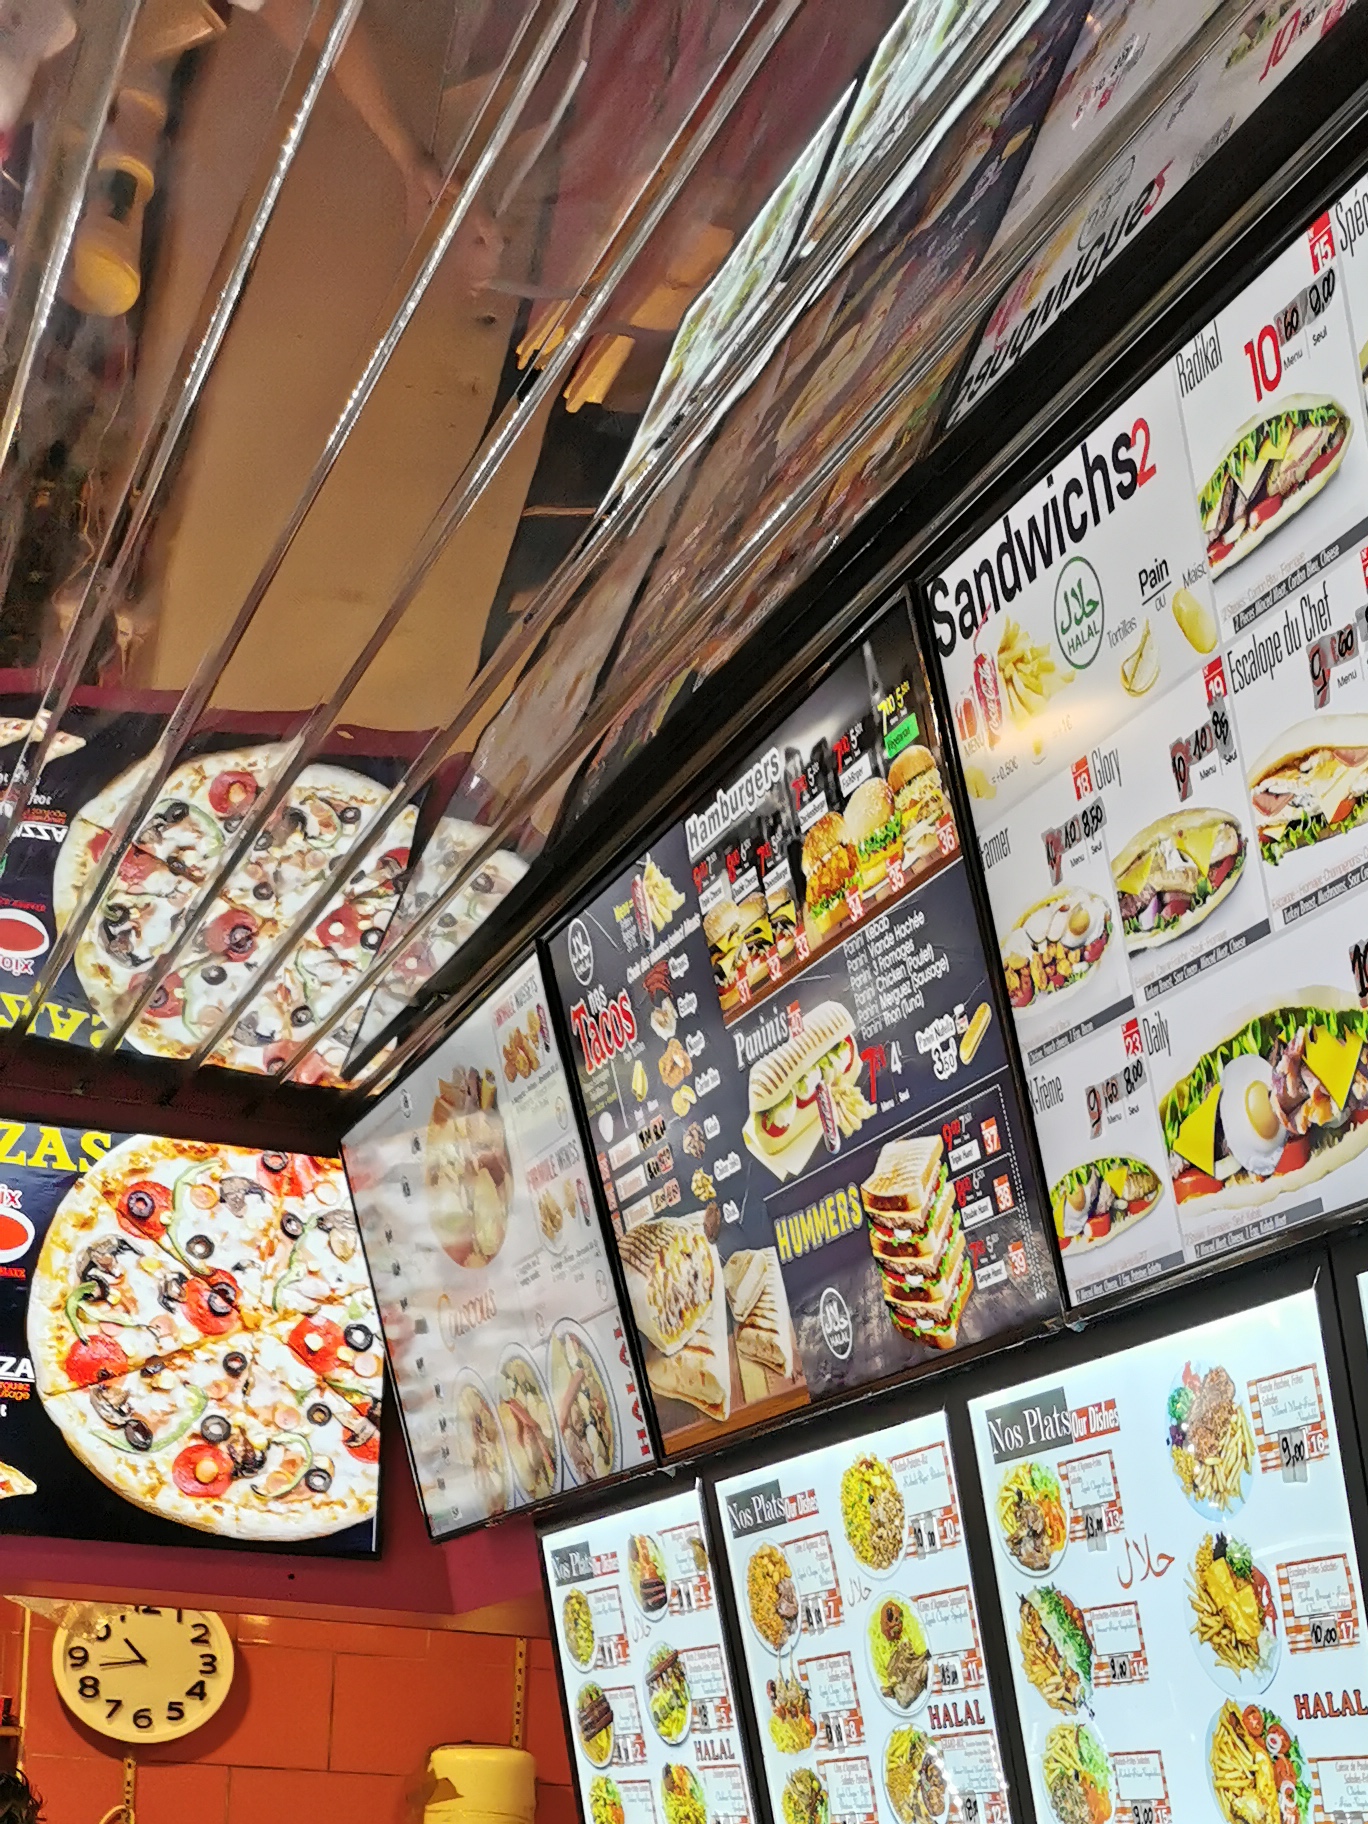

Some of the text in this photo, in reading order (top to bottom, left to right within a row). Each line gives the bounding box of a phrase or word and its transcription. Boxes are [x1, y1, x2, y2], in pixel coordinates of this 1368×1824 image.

[1175, 319, 1222, 398] Radikal
[1139, 559, 1170, 596] Pain
[1067, 621, 1100, 656] HALAL
[1227, 632, 1284, 695] Escalope
[1283, 610, 1302, 657] du
[1300, 579, 1333, 643] Chef
[1338, 671, 1358, 689] Menu
[1092, 747, 1122, 792] Glory
[686, 750, 782, 857] Hamburgers
[875, 964, 907, 993] Chicken
[878, 981, 912, 1012] Merguez
[571, 988, 637, 1076] Tacos
[734, 1006, 790, 1072] Paninis
[1142, 1010, 1171, 1057] Daily
[775, 1187, 863, 1263] HUMMERS
[988, 1402, 1120, 1455] Nos Plats Our Dishes
[1310, 1435, 1325, 1454] 16
[729, 1500, 752, 1531] Nos
[753, 1489, 786, 1525] Plats
[552, 1543, 593, 1582] Nos Plats
[1117, 1533, 1175, 1589] حلال
[191, 1623, 210, 1644] 2
[69, 1646, 89, 1668] 9
[199, 1653, 217, 1675] 3
[79, 1676, 100, 1698] 8
[185, 1680, 207, 1700] 4
[105, 1699, 123, 1719] 7
[133, 1708, 153, 1728] 6
[166, 1702, 185, 1720] 5
[928, 1699, 985, 1731] HALAL
[1294, 1689, 1368, 1720] HALAL
[694, 1739, 736, 1763] HALAL
